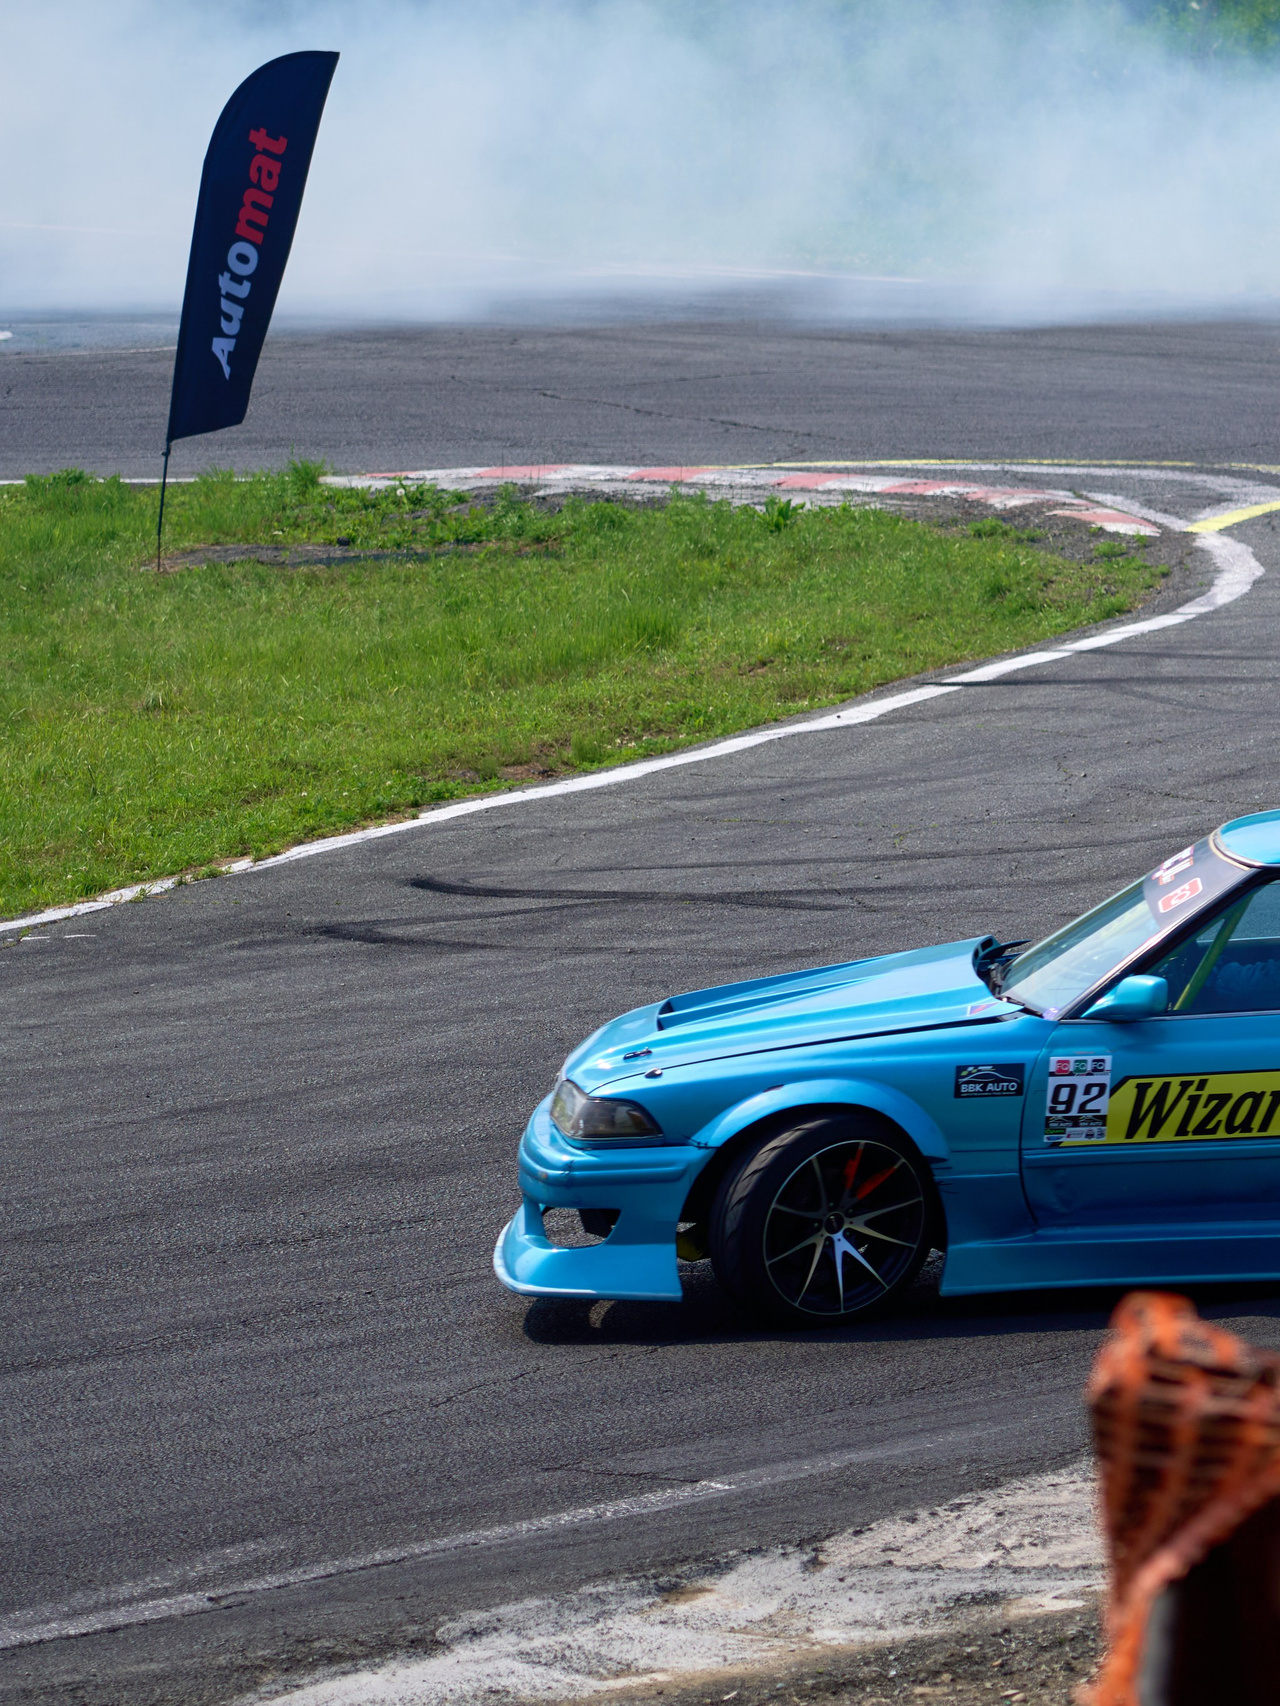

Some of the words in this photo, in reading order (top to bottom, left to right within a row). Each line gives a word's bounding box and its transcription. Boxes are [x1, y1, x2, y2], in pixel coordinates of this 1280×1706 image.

[211, 127, 288, 380] Automat
[961, 1084, 984, 1092] BBK
[986, 1082, 1018, 1091] AUTO
[1048, 1083, 1107, 1114] 92
